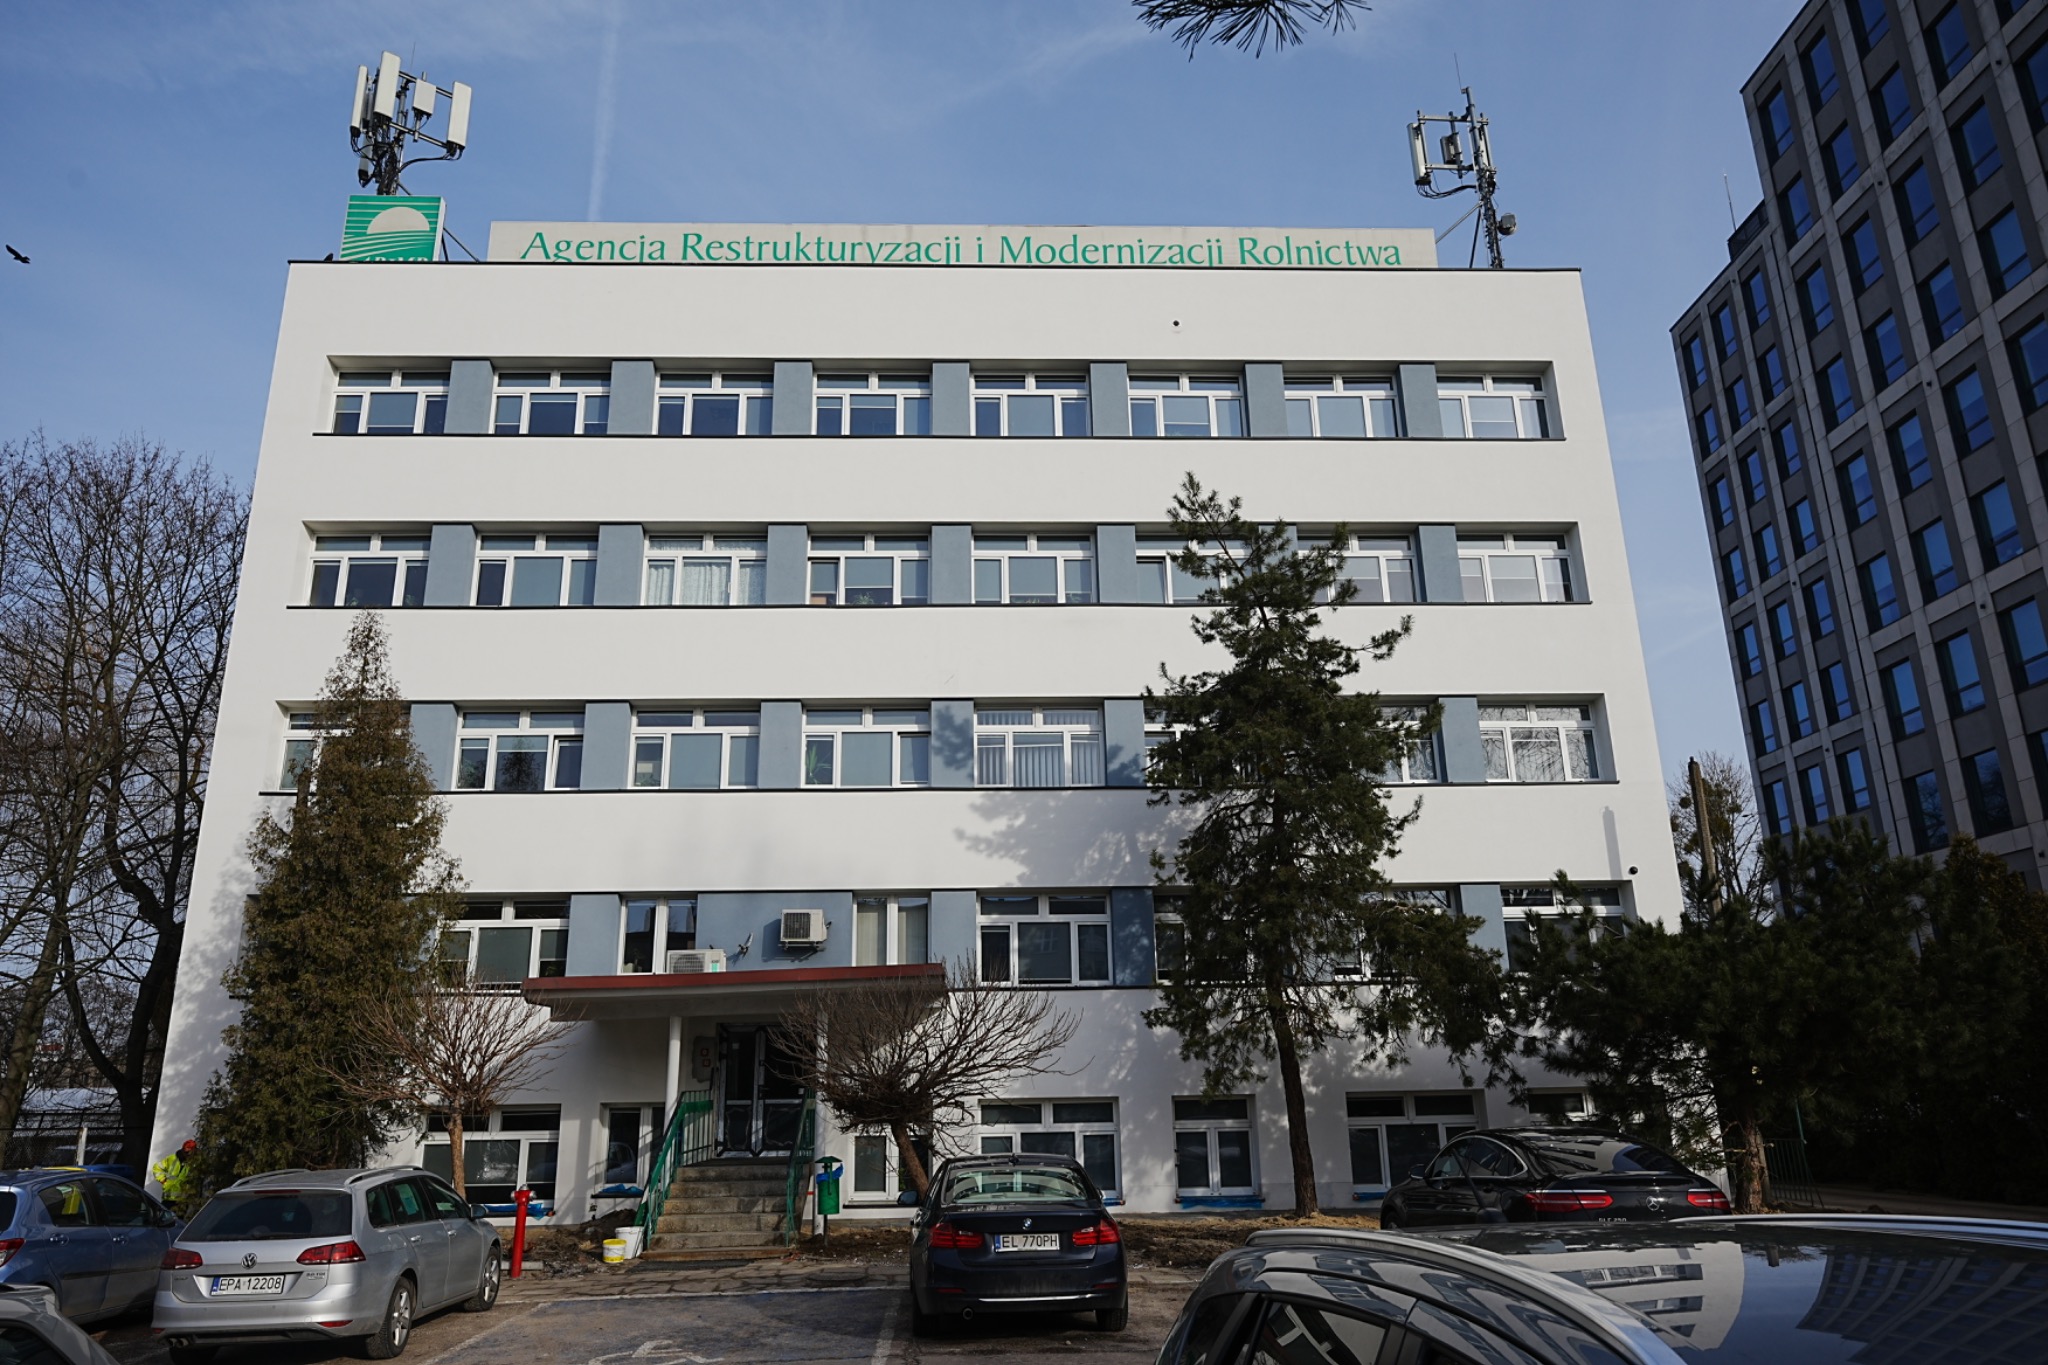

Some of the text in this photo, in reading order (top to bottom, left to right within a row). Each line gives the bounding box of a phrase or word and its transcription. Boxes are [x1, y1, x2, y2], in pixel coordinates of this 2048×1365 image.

[520, 231, 1402, 267] Agencja Restrukturyzacji i Modernizacji Rolnictwa
[1002, 1235, 1058, 1248] EL 770PH
[219, 1276, 282, 1292] EPA 12208
